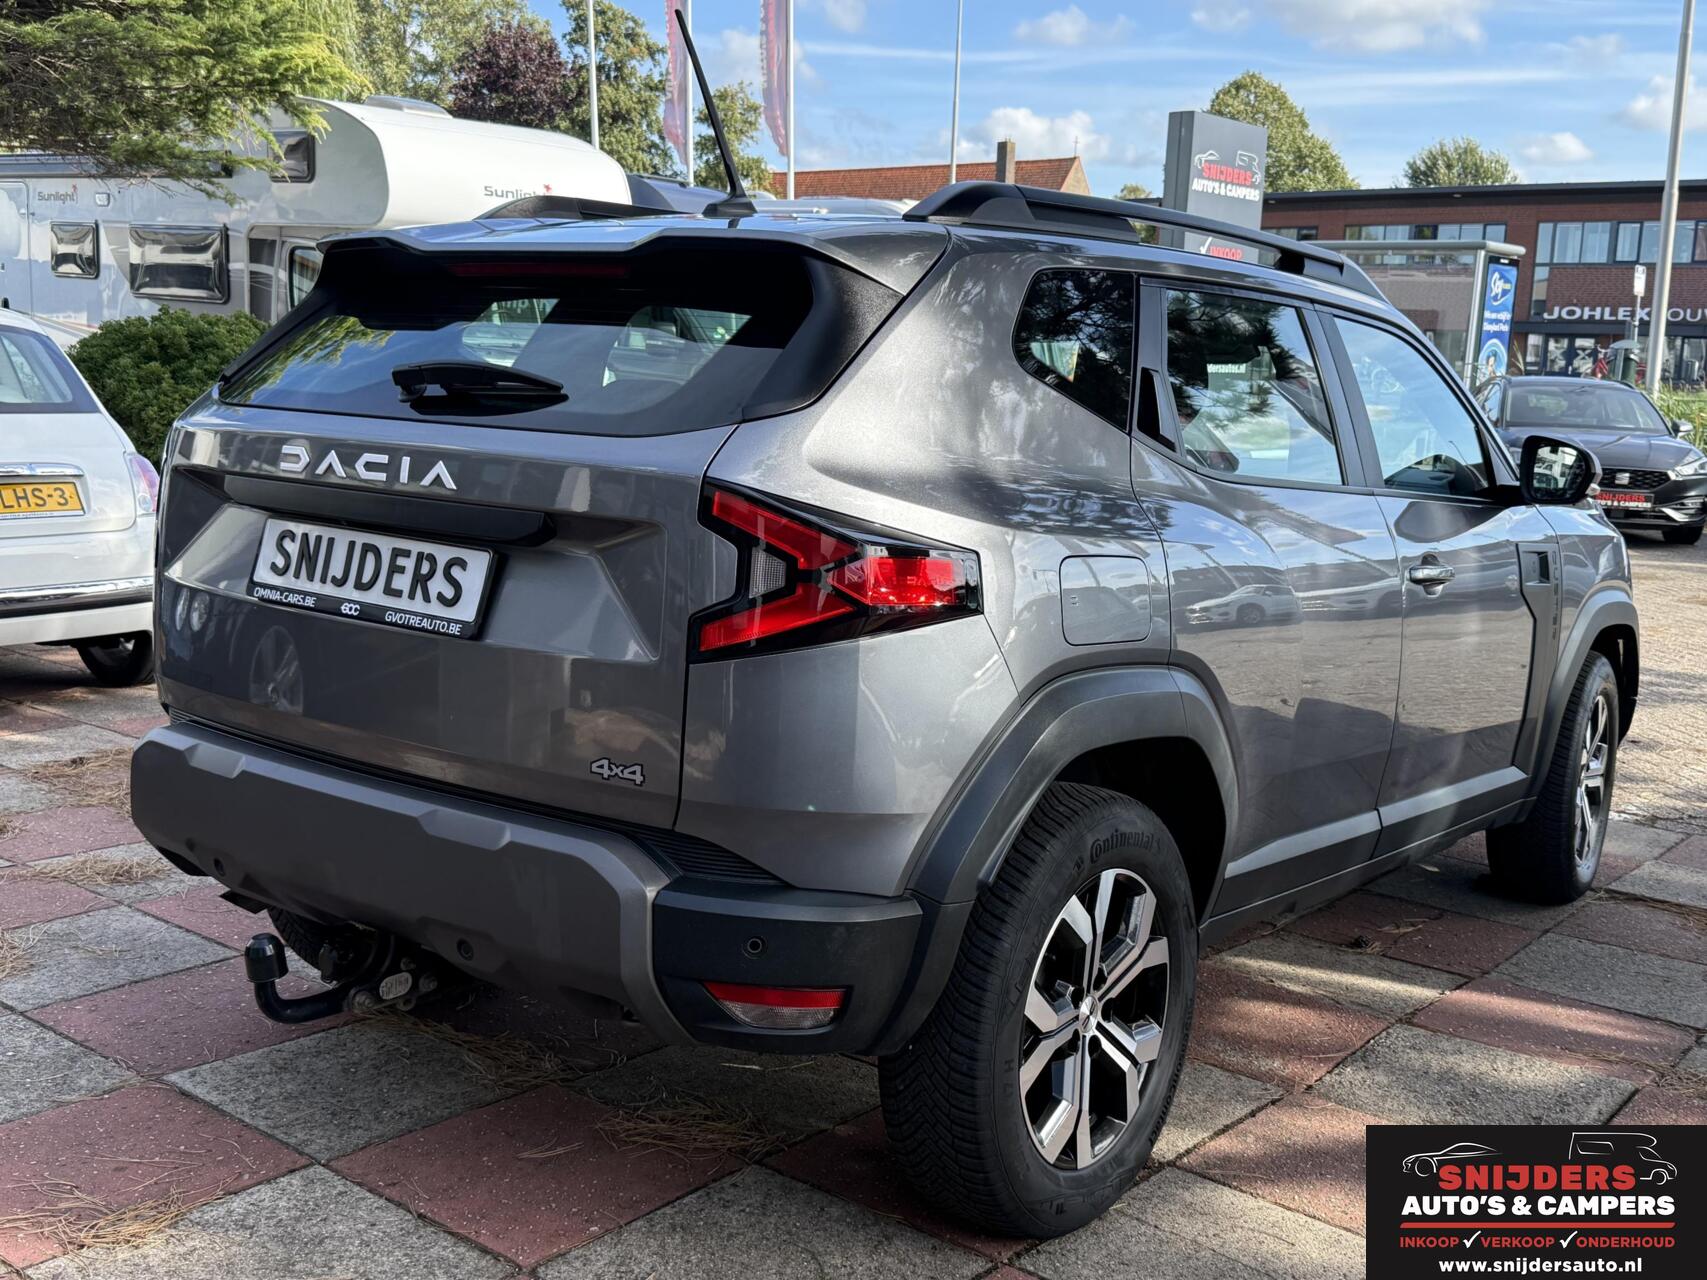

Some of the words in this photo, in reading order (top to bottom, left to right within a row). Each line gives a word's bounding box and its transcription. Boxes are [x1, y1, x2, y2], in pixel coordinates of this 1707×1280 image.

[1202, 162, 1253, 186] SNIJDERS
[37, 189, 76, 204] Sunlight
[484, 185, 546, 199] Sunli
[1192, 178, 1220, 195] AUTO'S
[1226, 185, 1260, 201] CAMPERS
[1667, 308, 1707, 322] OU
[280, 445, 457, 490] DACIA
[270, 529, 468, 608] SNIJDERS
[254, 587, 317, 608] OMNIA-CARS.BE
[385, 611, 463, 636] GVOTREAUTO.BE
[590, 757, 645, 786] 4x4
[1090, 828, 1154, 864] Continental
